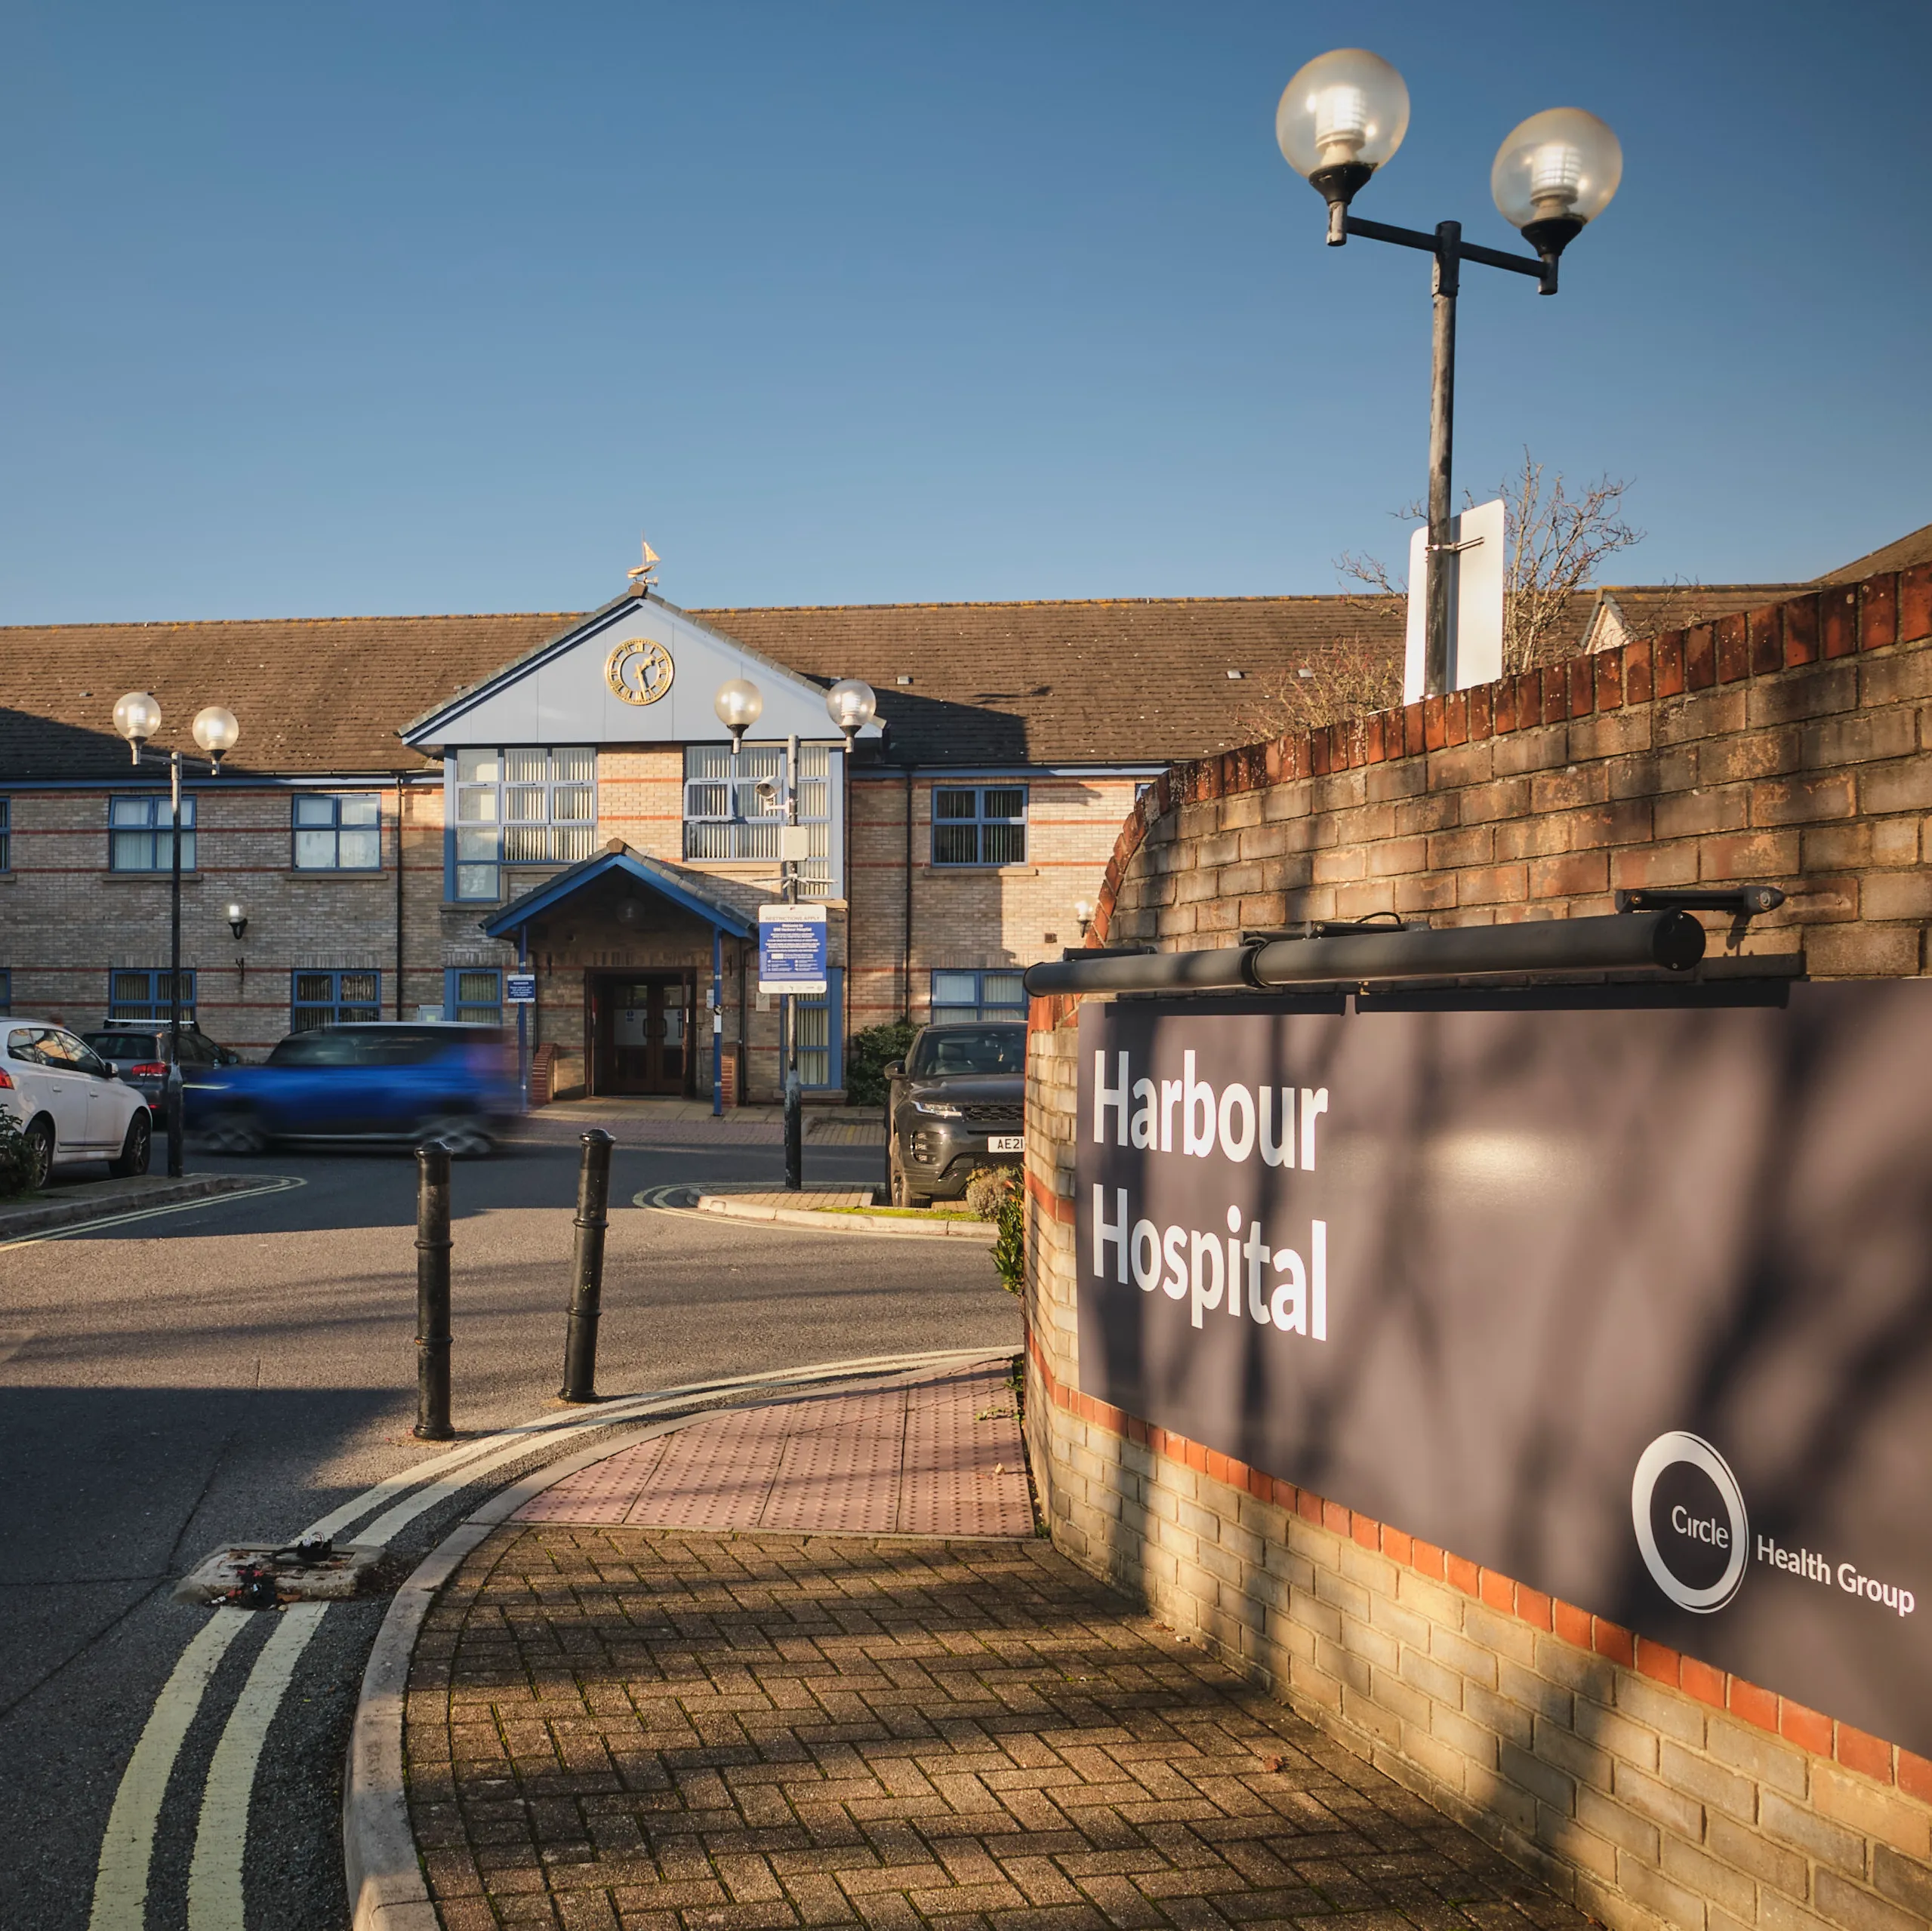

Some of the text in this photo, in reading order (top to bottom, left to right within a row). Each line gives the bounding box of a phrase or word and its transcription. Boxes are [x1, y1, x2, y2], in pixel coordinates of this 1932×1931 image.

[1093, 1049, 1329, 1172] Harbour
[1092, 1182, 1327, 1341] Hospital
[1672, 1504, 1729, 1549] Circle
[1757, 1534, 1915, 1617] Health Group
